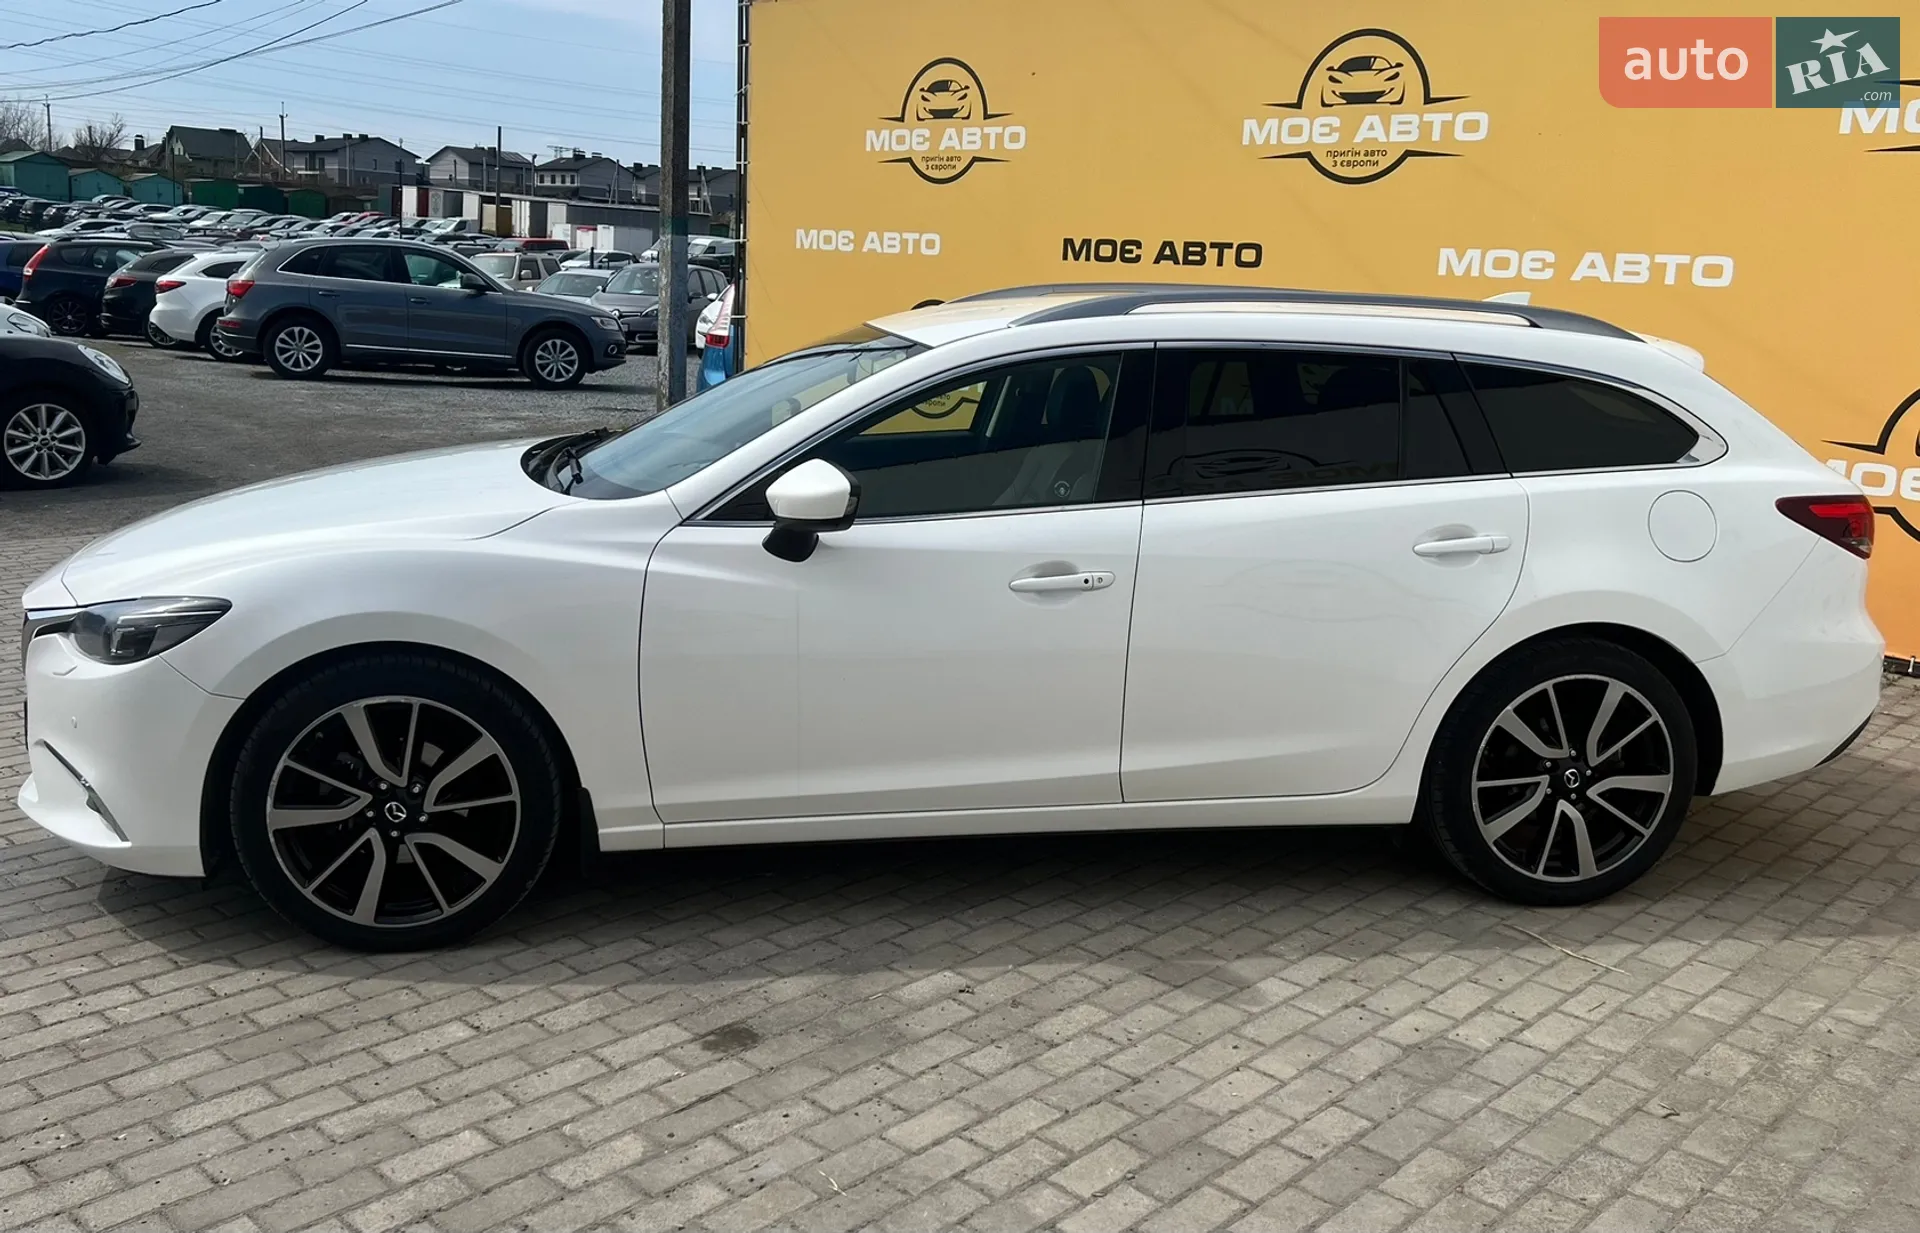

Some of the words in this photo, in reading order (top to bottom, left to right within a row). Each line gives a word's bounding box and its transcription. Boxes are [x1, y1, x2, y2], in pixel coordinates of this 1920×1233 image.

[866, 128, 931, 151] МОЄ
[939, 126, 1026, 150] АВТО
[1242, 116, 1340, 145] МОЄ
[1353, 111, 1489, 142] АВТО
[921, 154, 944, 163] пригін
[1326, 148, 1361, 160] пригін
[1363, 149, 1388, 157] авто
[1332, 160, 1338, 168] з
[1340, 159, 1380, 169] європи
[795, 229, 854, 252] МОЄ
[862, 231, 941, 255] АВТО
[1061, 237, 1142, 264] МОЄ
[1152, 240, 1263, 269] АВТО
[1437, 248, 1555, 280] МОЄ
[1569, 252, 1734, 287] АВТО
